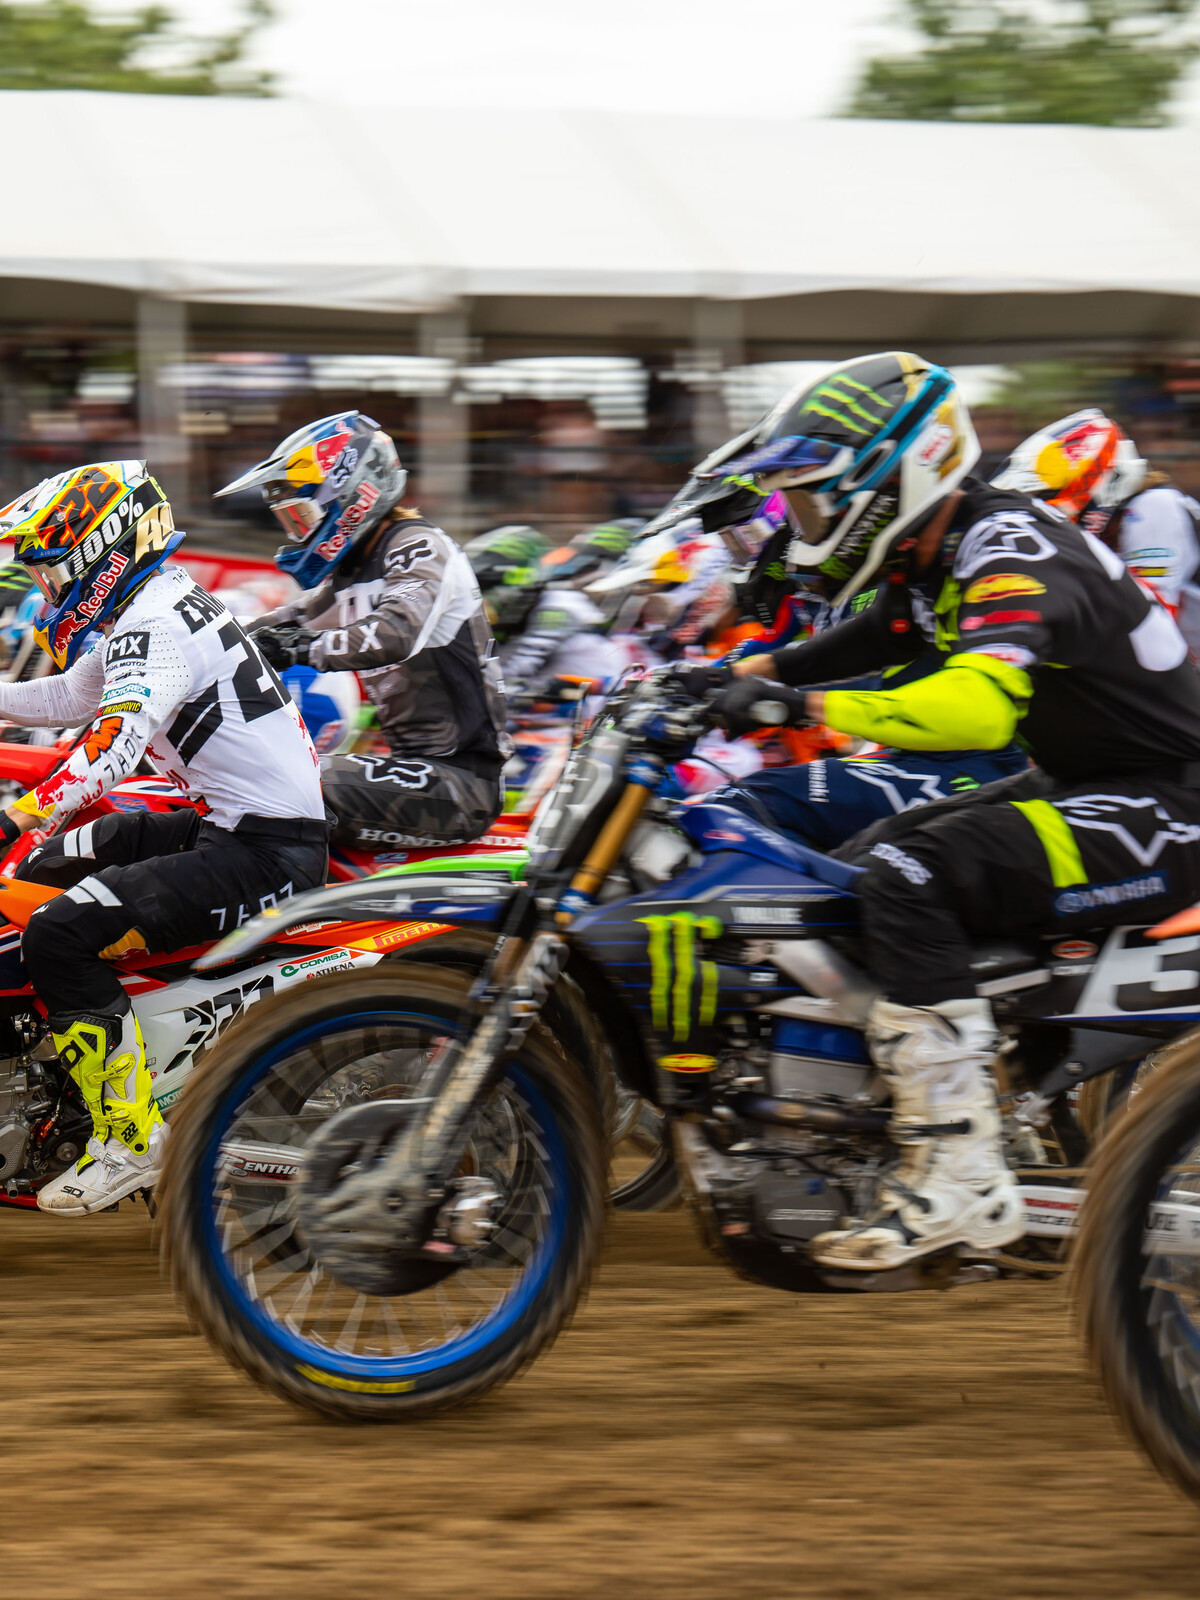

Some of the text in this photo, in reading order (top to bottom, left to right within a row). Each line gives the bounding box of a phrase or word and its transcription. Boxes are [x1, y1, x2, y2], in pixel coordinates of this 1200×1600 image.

[67, 493, 144, 576] 100%
[77, 549, 130, 619] Red Bull
[107, 684, 147, 700] MOTOREX
[299, 950, 349, 970] COMISA
[315, 961, 356, 979] ATHENA
